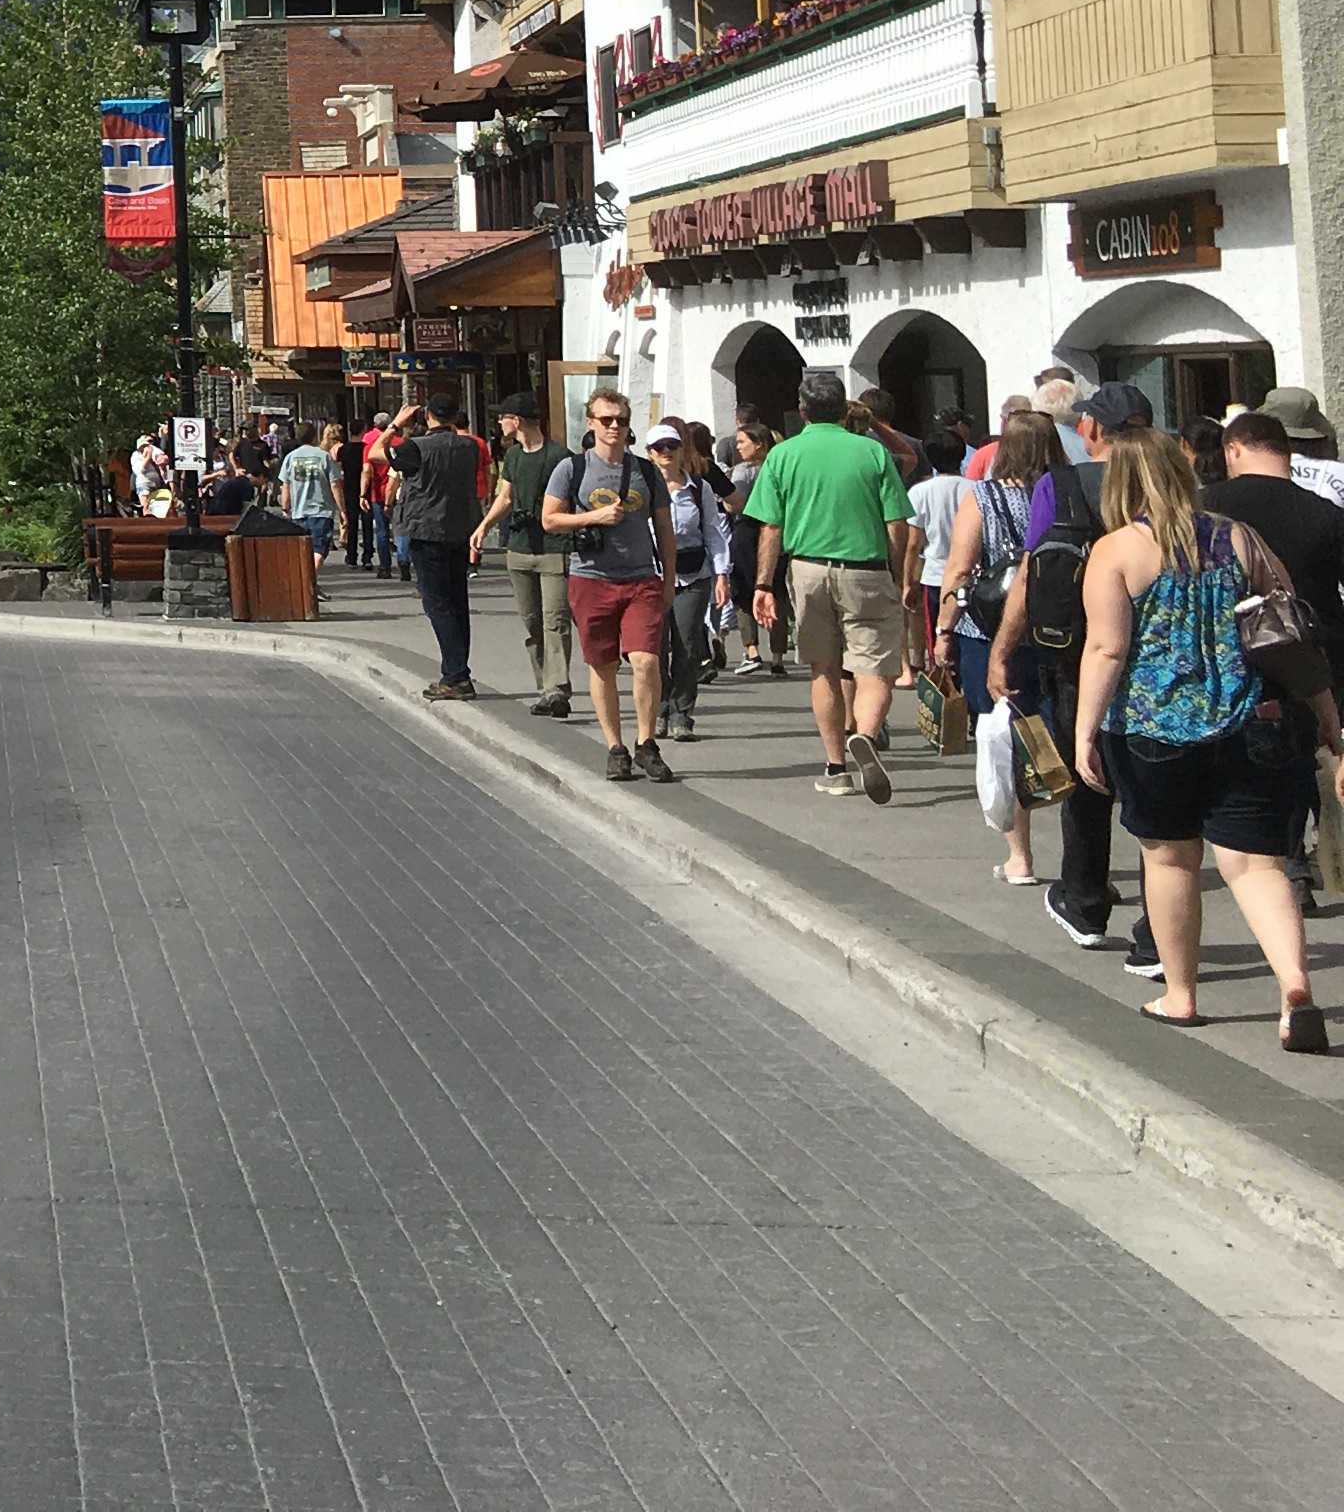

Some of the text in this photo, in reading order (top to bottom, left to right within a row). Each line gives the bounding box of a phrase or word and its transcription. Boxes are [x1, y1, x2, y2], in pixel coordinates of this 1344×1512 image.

[129, 196, 146, 205] and
[649, 162, 880, 253] CLOCK TOWER VILLAGE MALL
[422, 329, 449, 337] PIZZA
